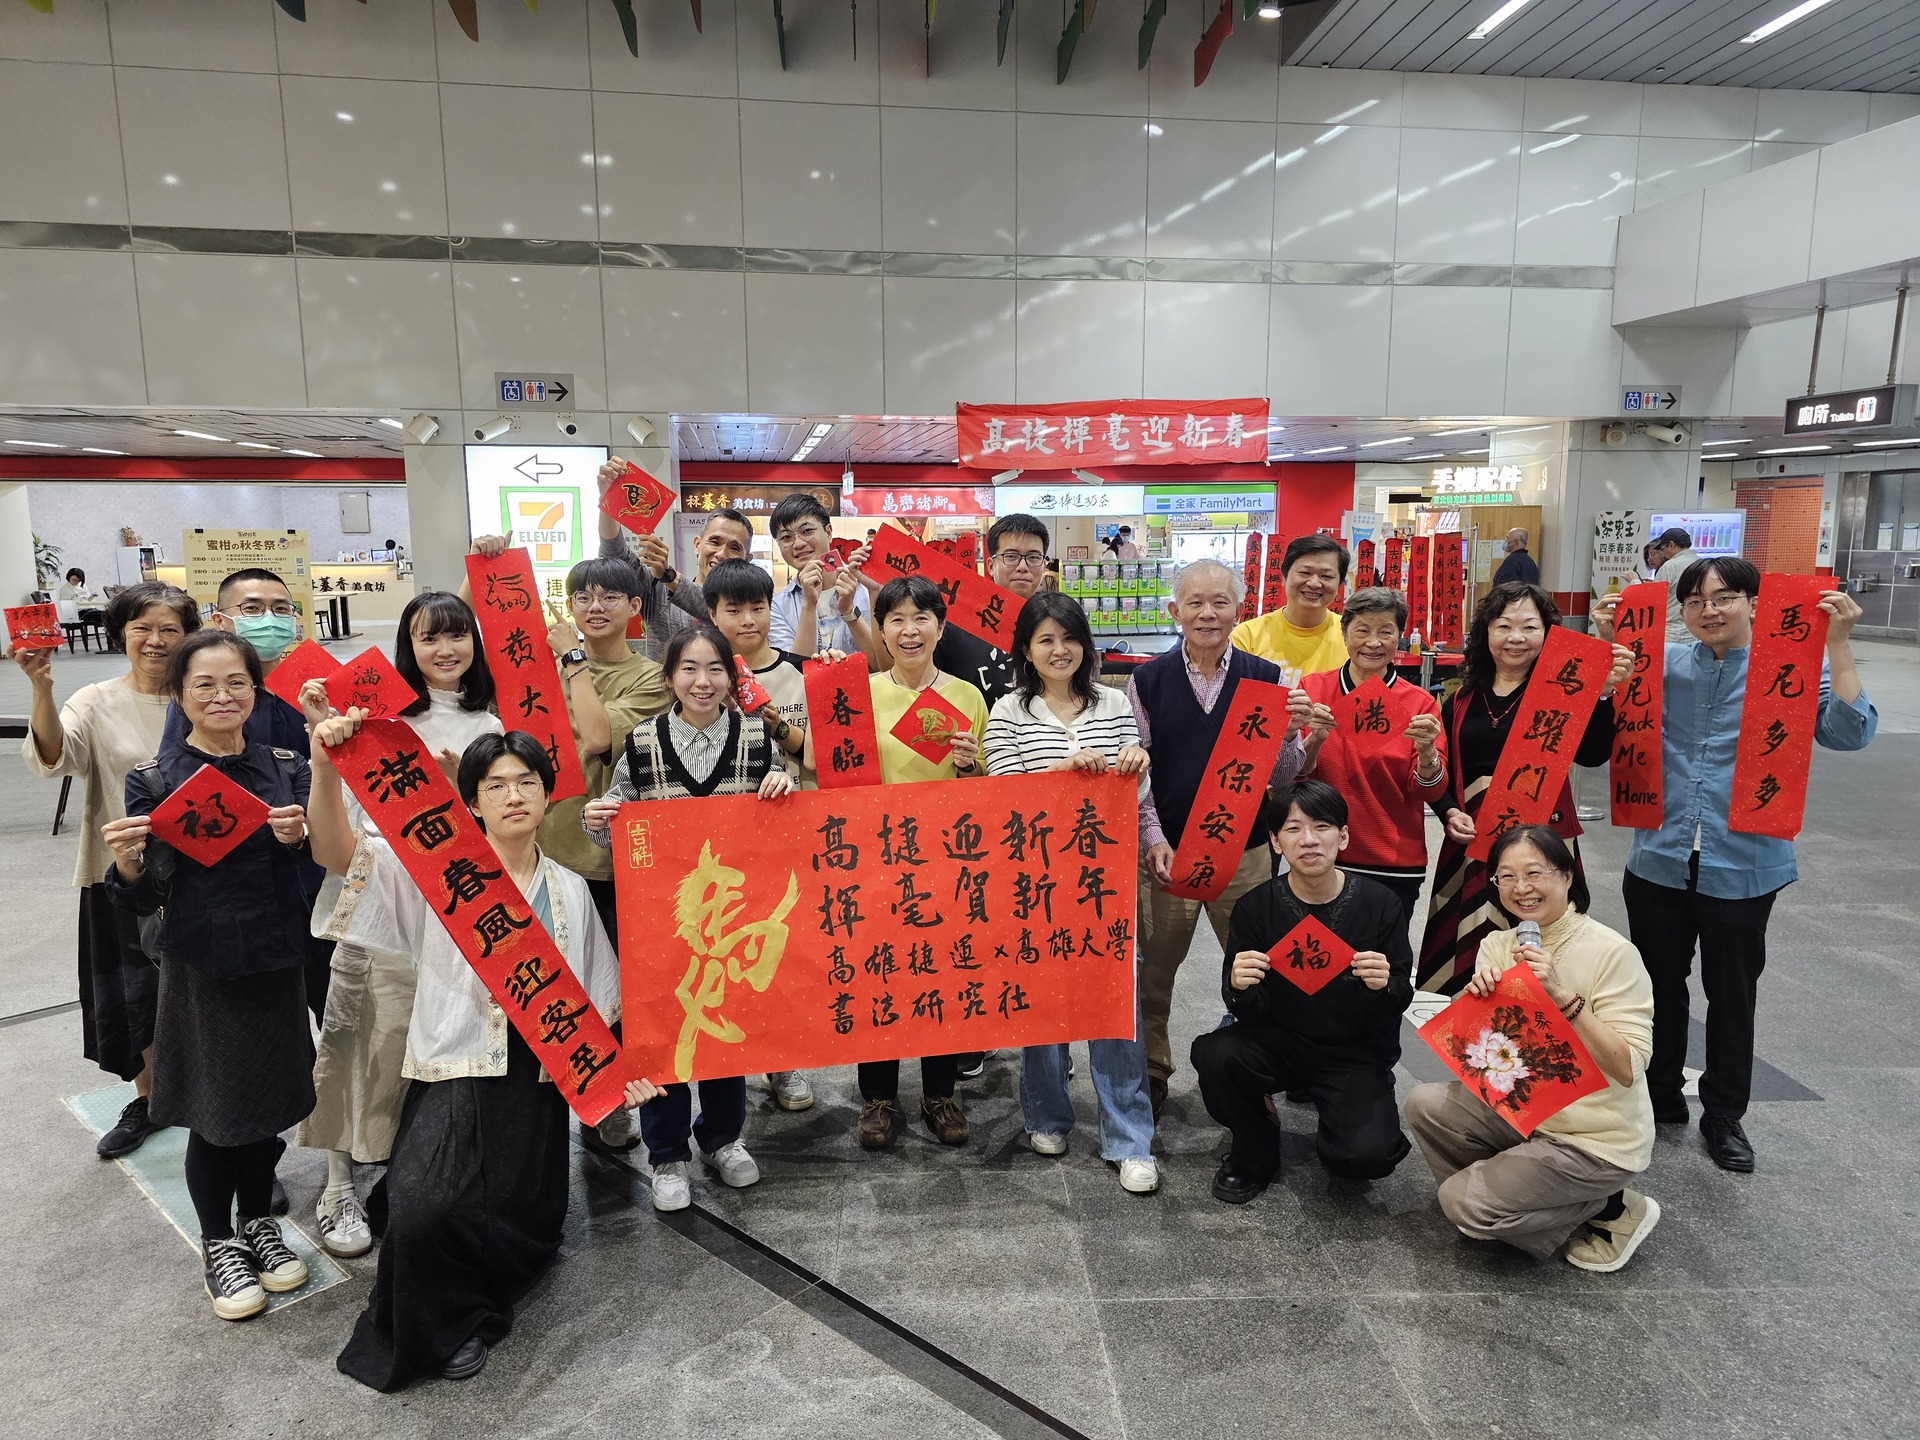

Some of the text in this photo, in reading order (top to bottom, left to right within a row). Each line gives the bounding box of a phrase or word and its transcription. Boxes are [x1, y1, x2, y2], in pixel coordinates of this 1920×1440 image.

[981, 411, 1254, 455] 高捷揮毫迎新春
[1797, 404, 1855, 426] 廁所 Toilets
[733, 498, 765, 510] 美食坊
[1175, 496, 1262, 510] 全家 FamilyMart
[206, 540, 275, 551] 蜜柑の秋冬祭
[1600, 543, 1634, 554] 四季春茶
[352, 581, 386, 592] 美食坊
[885, 552, 1017, 636] 馬上加
[1617, 605, 1655, 633] All
[354, 665, 381, 686] 滿
[1354, 696, 1390, 735] 滿
[1616, 709, 1655, 734] Back
[1751, 603, 1811, 812] 馬尼多多
[825, 687, 864, 773] 春臨
[1615, 742, 1647, 768] Me
[1179, 706, 1271, 889] 永保安康
[1615, 780, 1658, 806] Home
[174, 792, 239, 842] 福
[811, 798, 1119, 872] 高捷迎新春
[631, 824, 650, 866] 吉祥
[364, 749, 616, 1095] 滿面春風迎客至
[819, 865, 1118, 940] 揮毫賀新年
[1285, 932, 1331, 971] 福
[827, 981, 1031, 1035] 書法研究社
